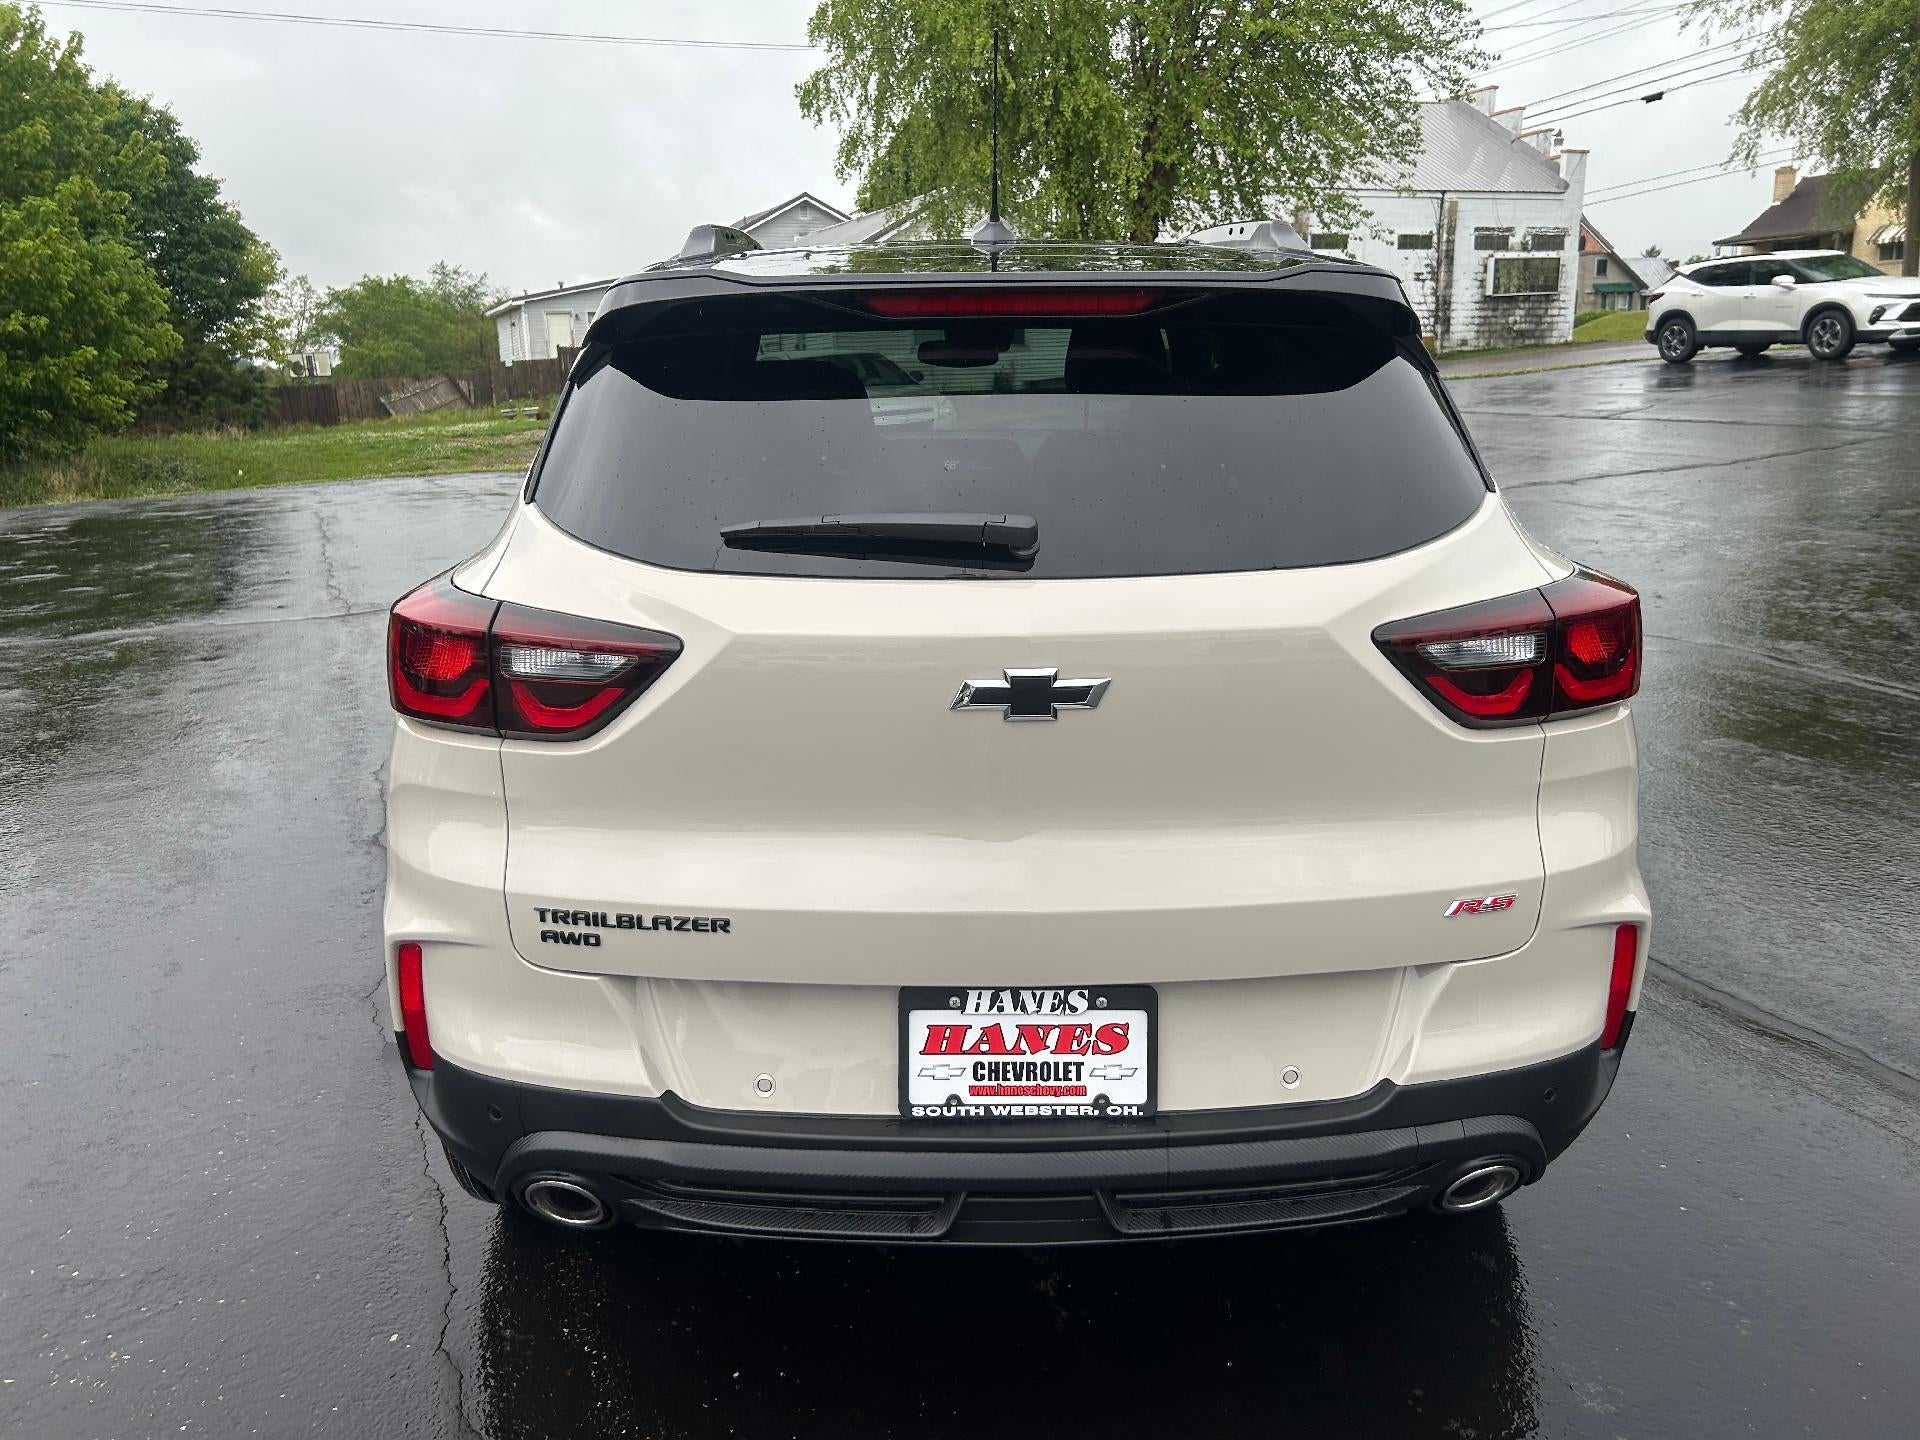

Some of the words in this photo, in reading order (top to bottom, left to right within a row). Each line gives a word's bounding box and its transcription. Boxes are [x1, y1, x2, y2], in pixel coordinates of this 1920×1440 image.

[1443, 893, 1518, 917] RS
[533, 907, 731, 933] TRAILBLAZER
[540, 929, 602, 947] AWD
[961, 988, 1089, 1016] HANES
[919, 1022, 1130, 1057] HANES
[972, 1060, 1085, 1082] CHEVROLET
[911, 1105, 985, 1117] SOUTH
[992, 1105, 1100, 1117] WEBSTER,
[1106, 1105, 1144, 1117] OH.
